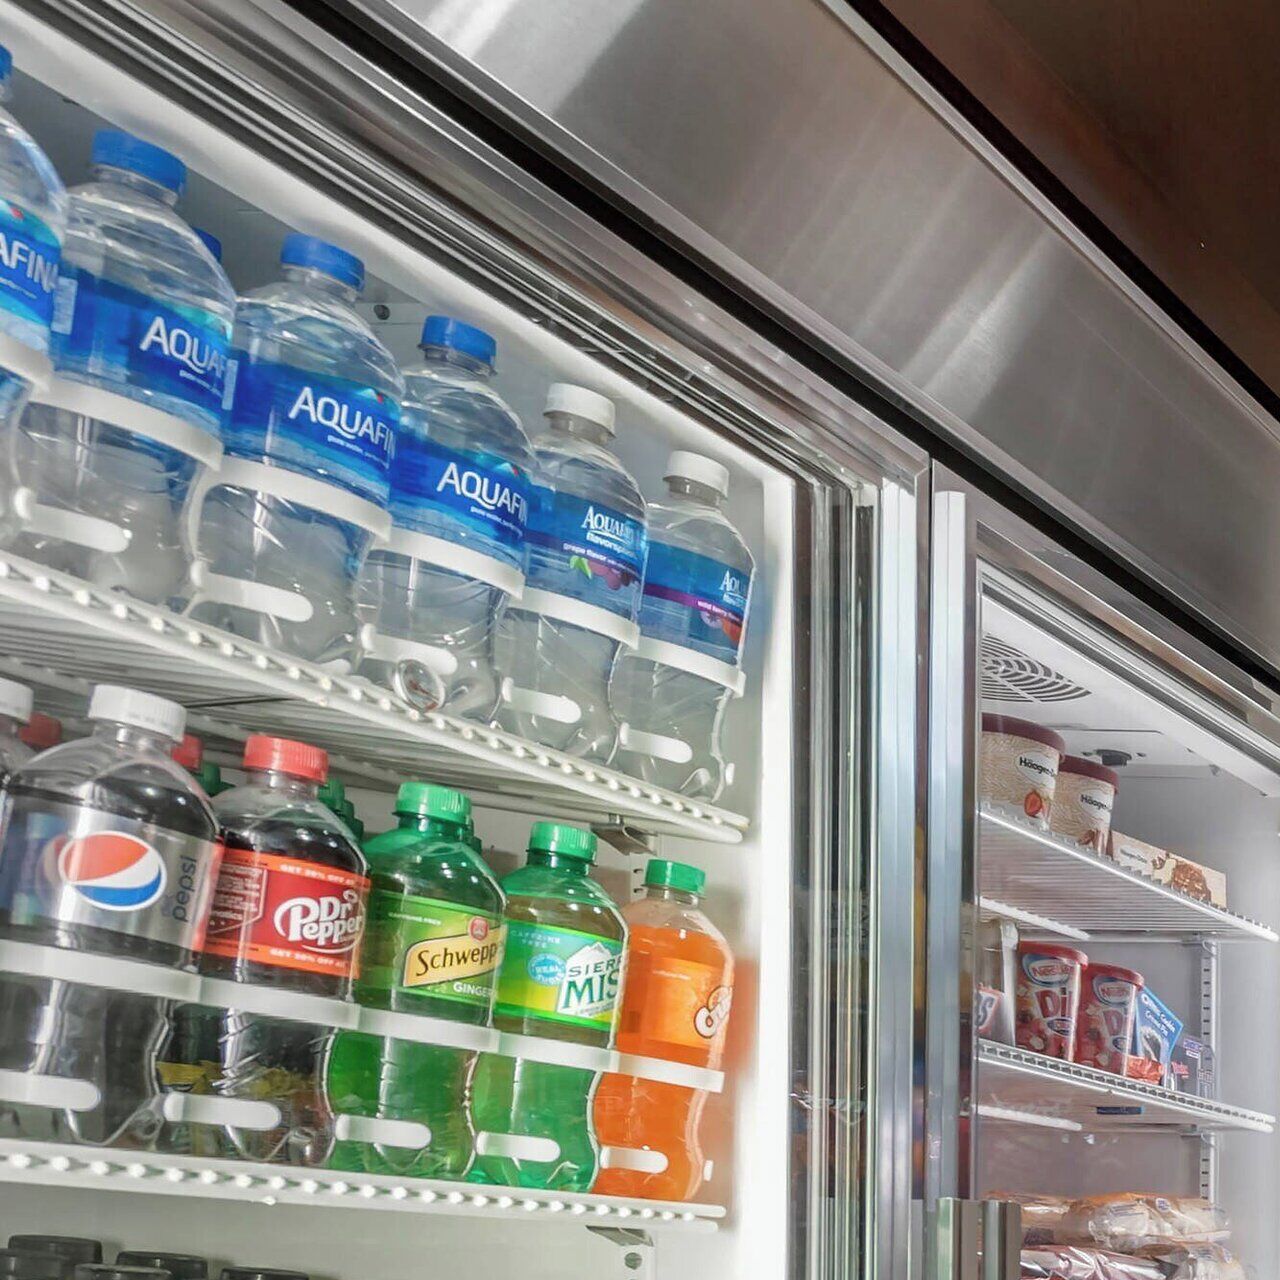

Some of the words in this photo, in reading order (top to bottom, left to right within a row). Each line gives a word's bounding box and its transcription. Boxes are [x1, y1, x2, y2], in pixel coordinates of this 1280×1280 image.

[171, 853, 198, 924] pepsi
[319, 889, 358, 923] Dr
[273, 896, 363, 947] Pepper
